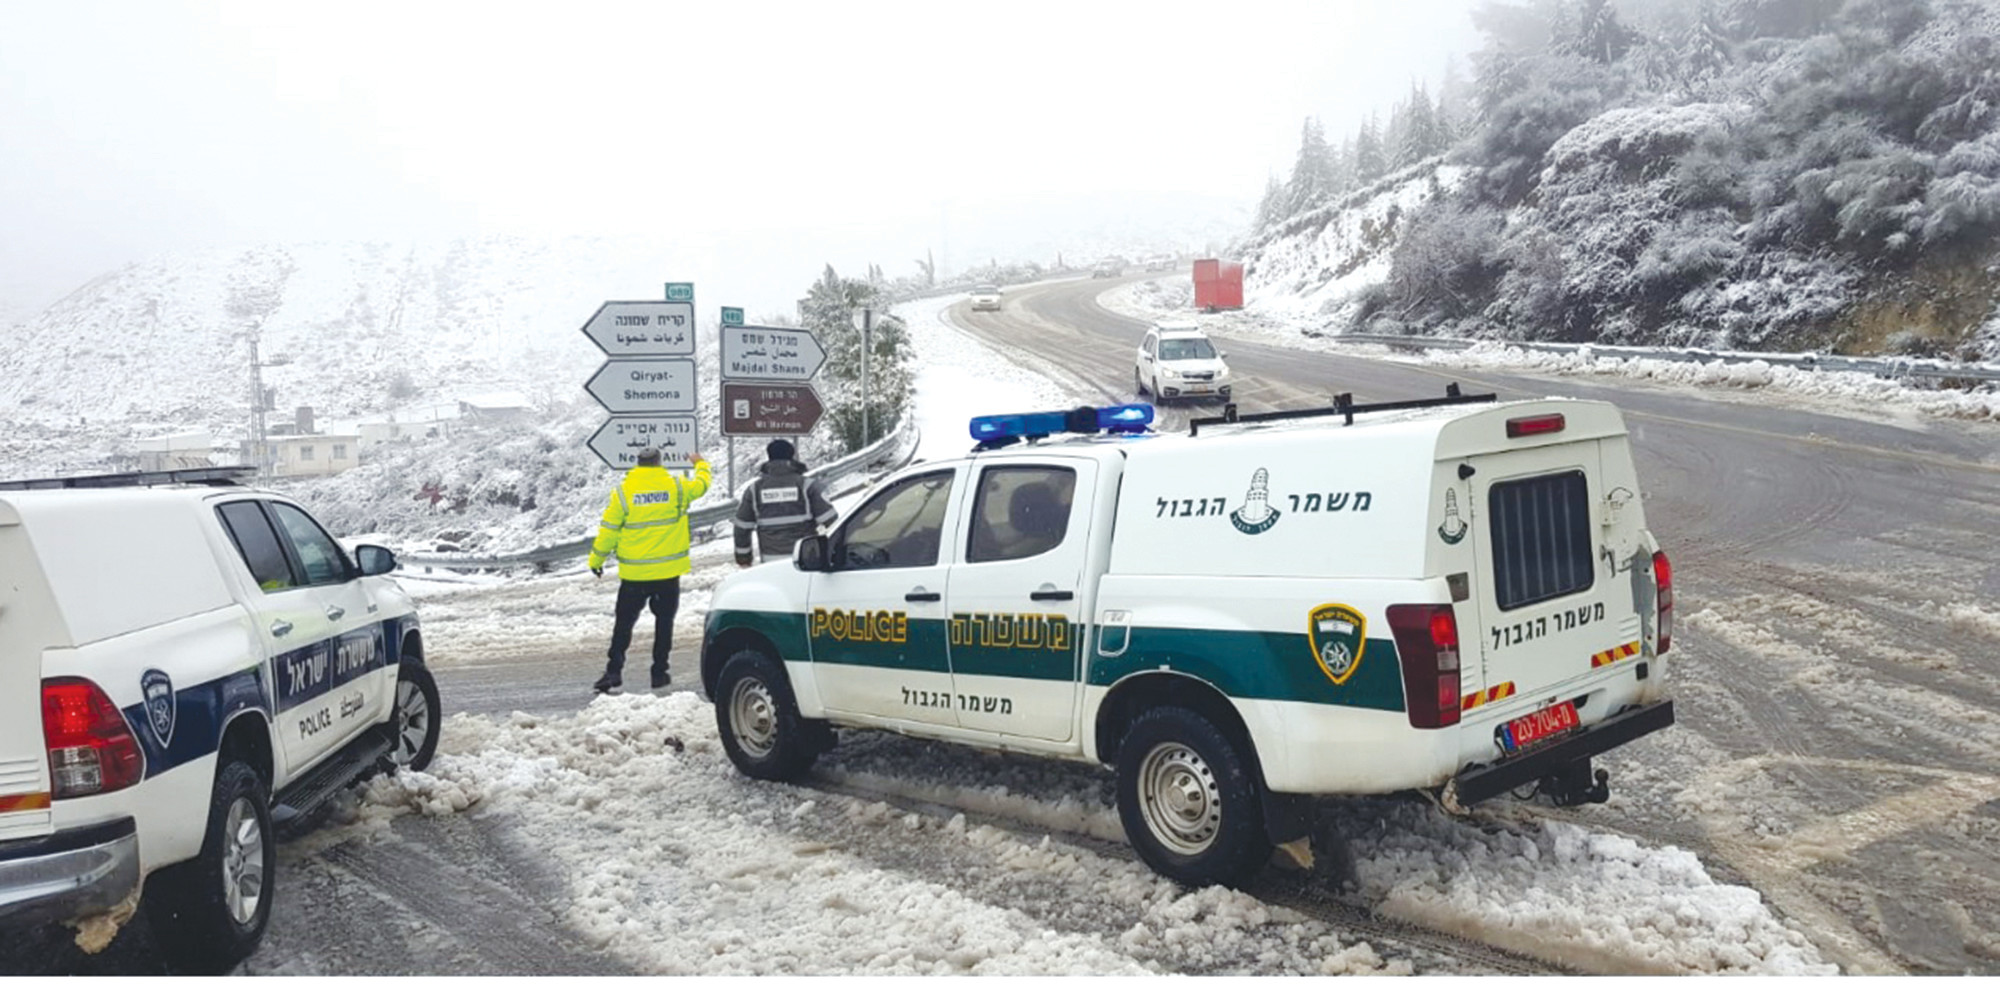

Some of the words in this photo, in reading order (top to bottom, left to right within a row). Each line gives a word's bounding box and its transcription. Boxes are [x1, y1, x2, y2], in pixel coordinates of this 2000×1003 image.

[616, 315, 650, 326] שמונה
[631, 371, 674, 382] Qiryat-
[732, 362, 767, 374] Majdal
[771, 363, 806, 374] Shams
[624, 389, 680, 400] Shemona
[664, 422, 690, 433] נווה
[633, 492, 669, 504] משטרה
[1156, 497, 1227, 518] הגבול
[1288, 491, 1373, 512] משמר
[812, 608, 907, 642] POLICE
[1553, 601, 1605, 630] משמר
[952, 612, 1070, 650] משטרה
[1491, 616, 1547, 650] הגבול
[338, 634, 375, 675] משטרת
[287, 651, 328, 696] ישראל
[902, 686, 950, 706] הגבול
[957, 693, 1013, 714] משמר
[299, 707, 332, 740] POLICE
